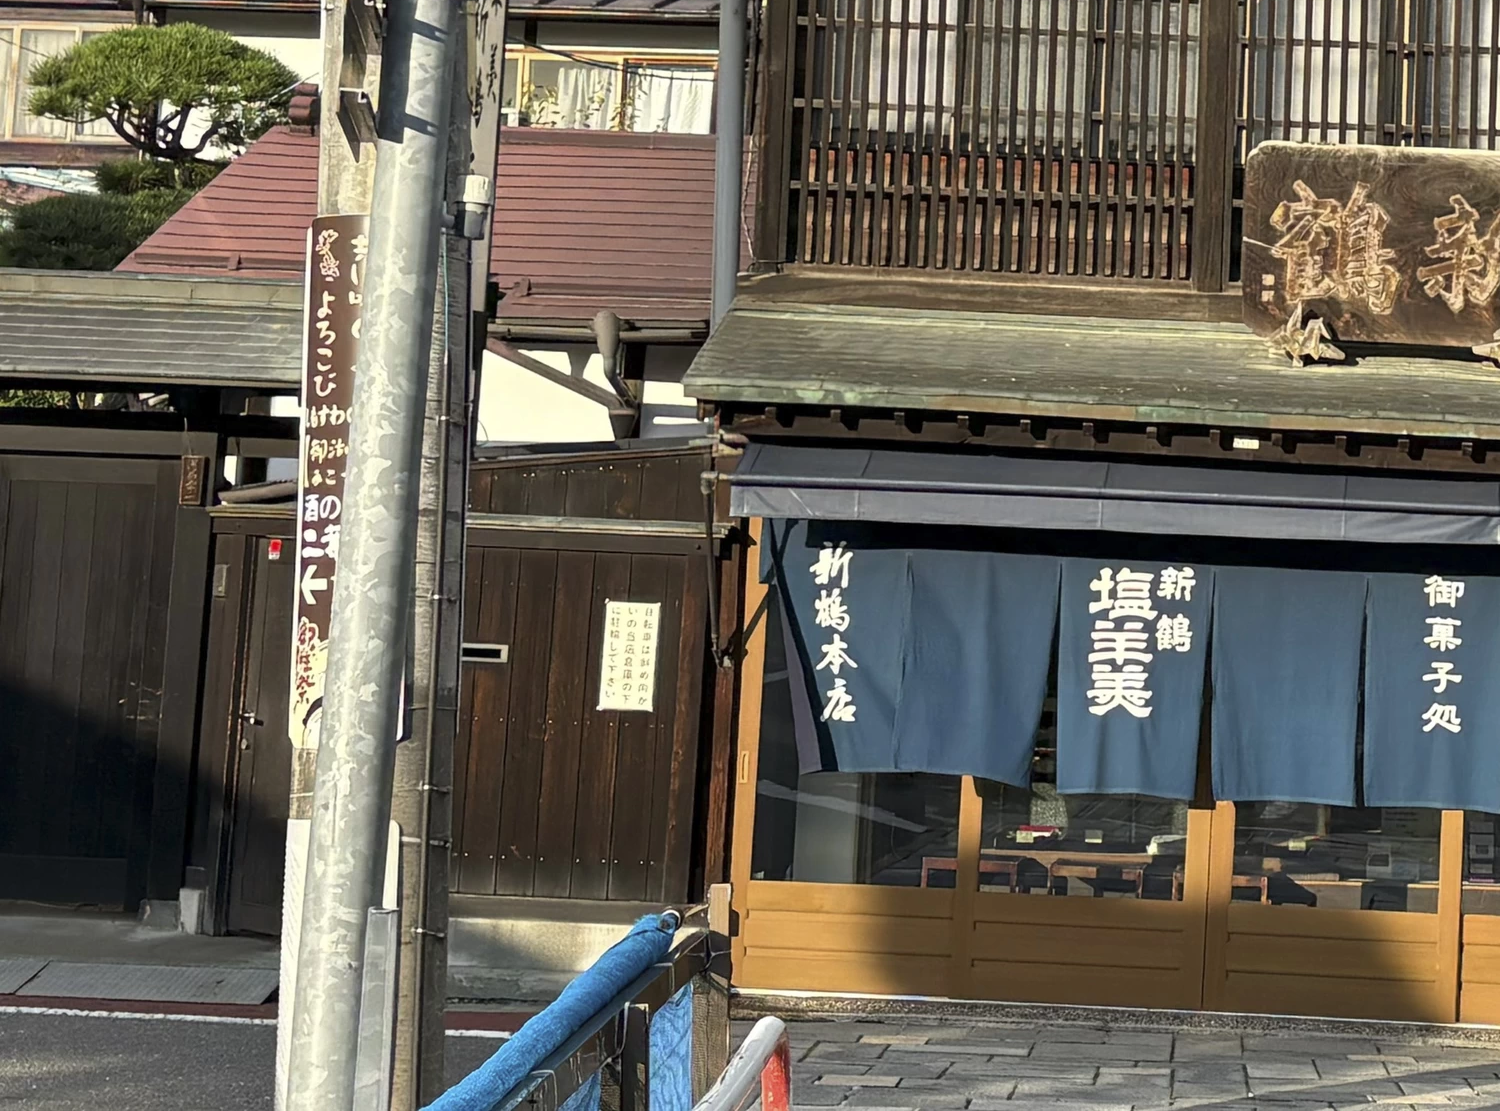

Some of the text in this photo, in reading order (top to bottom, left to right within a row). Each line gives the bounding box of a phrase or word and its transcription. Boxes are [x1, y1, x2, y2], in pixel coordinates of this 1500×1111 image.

[313, 290, 337, 397] よろこび
[809, 541, 858, 723] 新鶴本店
[1154, 565, 1197, 653] 新鶴
[1421, 574, 1465, 734] 御菓子処
